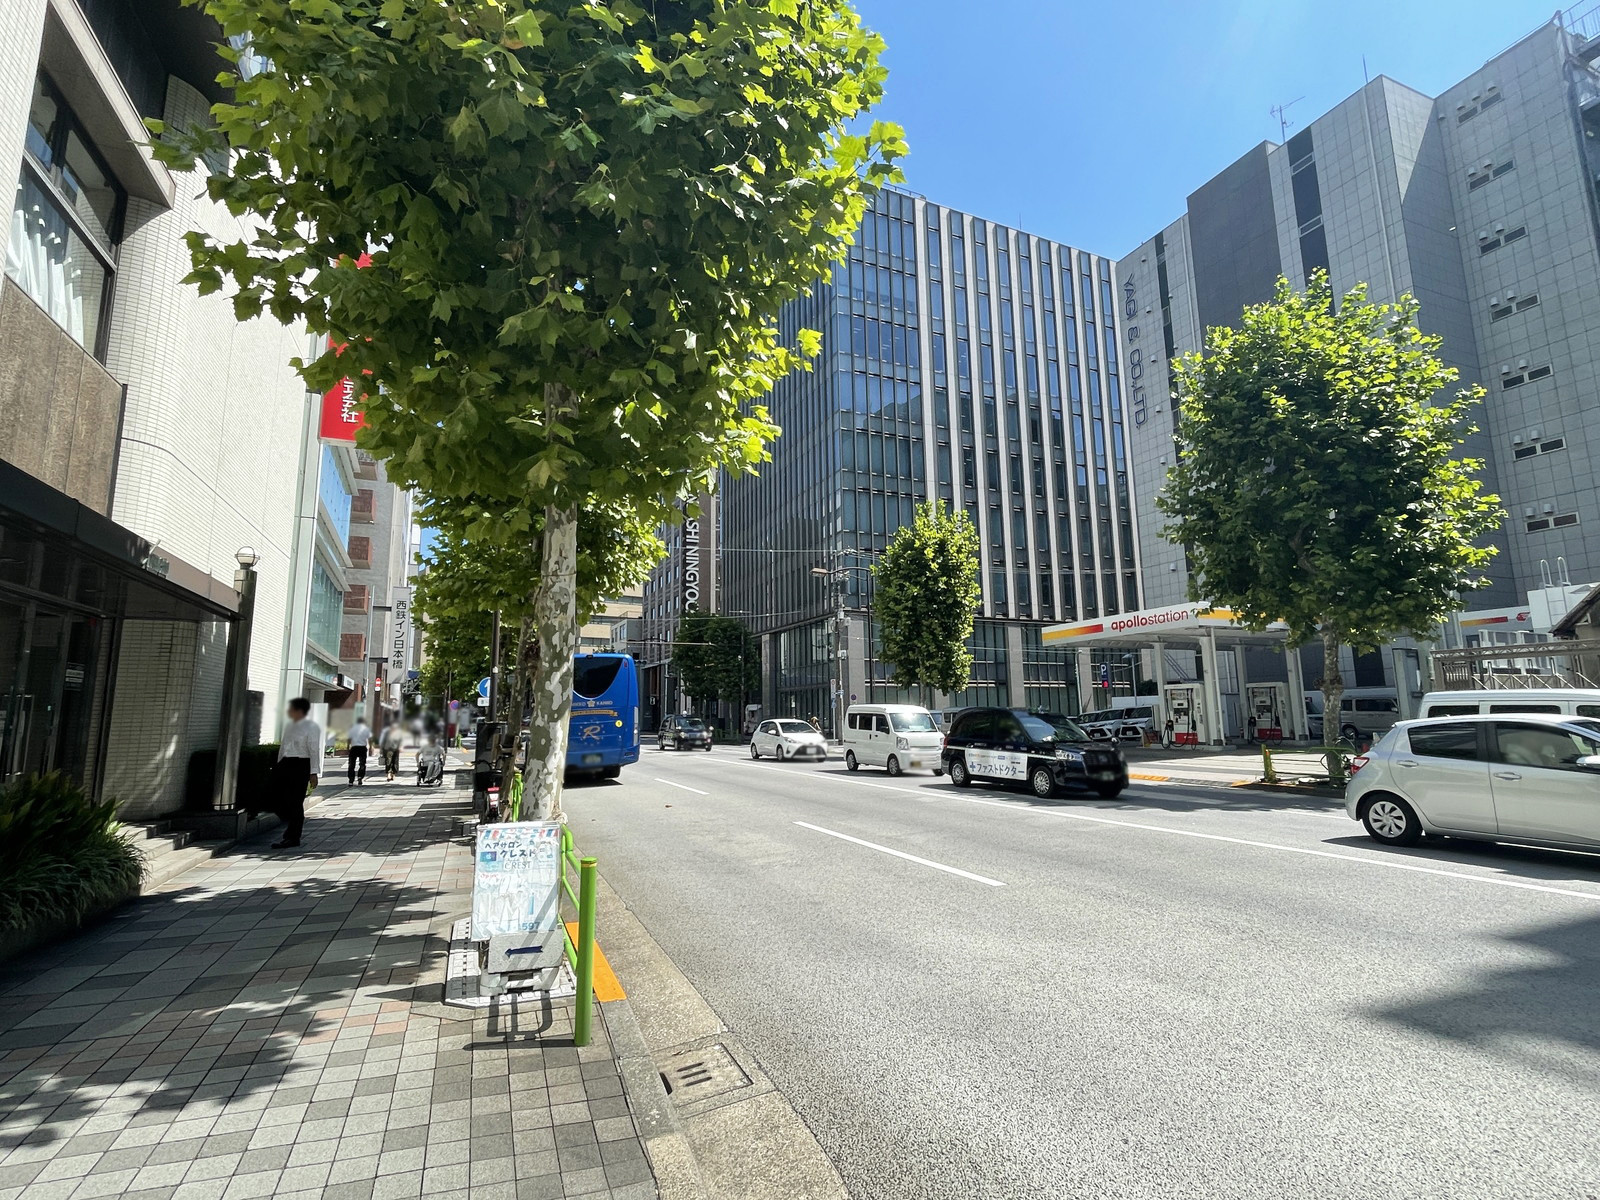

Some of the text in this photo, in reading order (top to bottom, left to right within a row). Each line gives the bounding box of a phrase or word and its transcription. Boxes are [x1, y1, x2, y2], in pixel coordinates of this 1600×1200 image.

[1123, 274, 1138, 321] YAGI
[1127, 326, 1139, 344] &
[1111, 610, 1189, 632] apollostation
[392, 600, 407, 669] 西鉄イン日本橋
[1101, 664, 1107, 675] P
[582, 726, 601, 740] R
[977, 763, 1025, 776] ファストドクター
[485, 841, 522, 849] ヘアサロン
[504, 861, 532, 869] CREST
